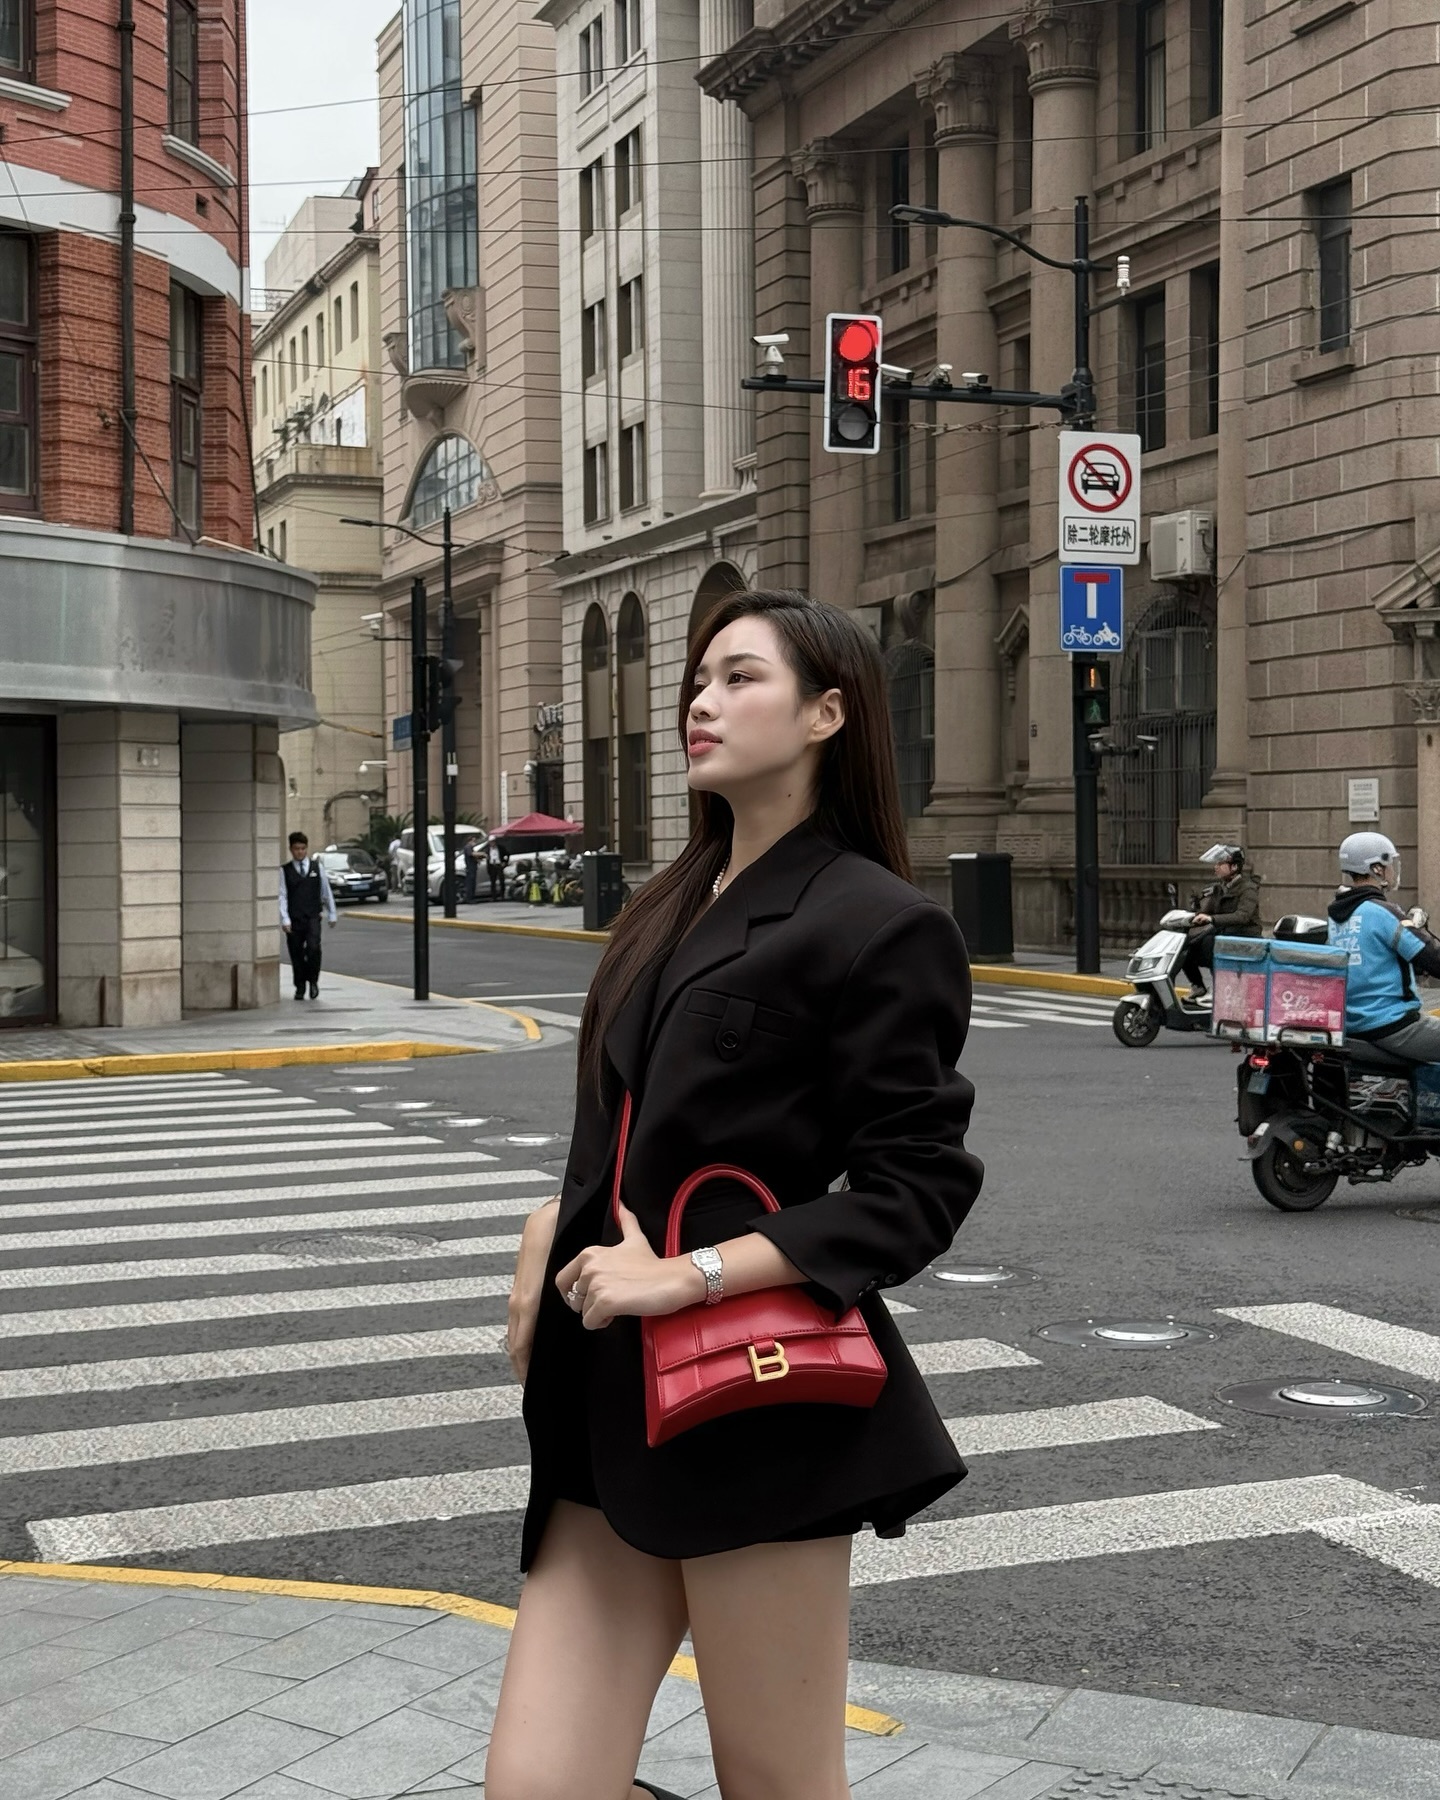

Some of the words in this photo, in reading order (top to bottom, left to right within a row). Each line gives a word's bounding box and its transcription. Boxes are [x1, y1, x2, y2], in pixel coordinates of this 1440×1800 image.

[848, 368, 870, 400] 16
[1067, 524, 1132, 547] 除二轮摩托外
[748, 1341, 790, 1383] B
